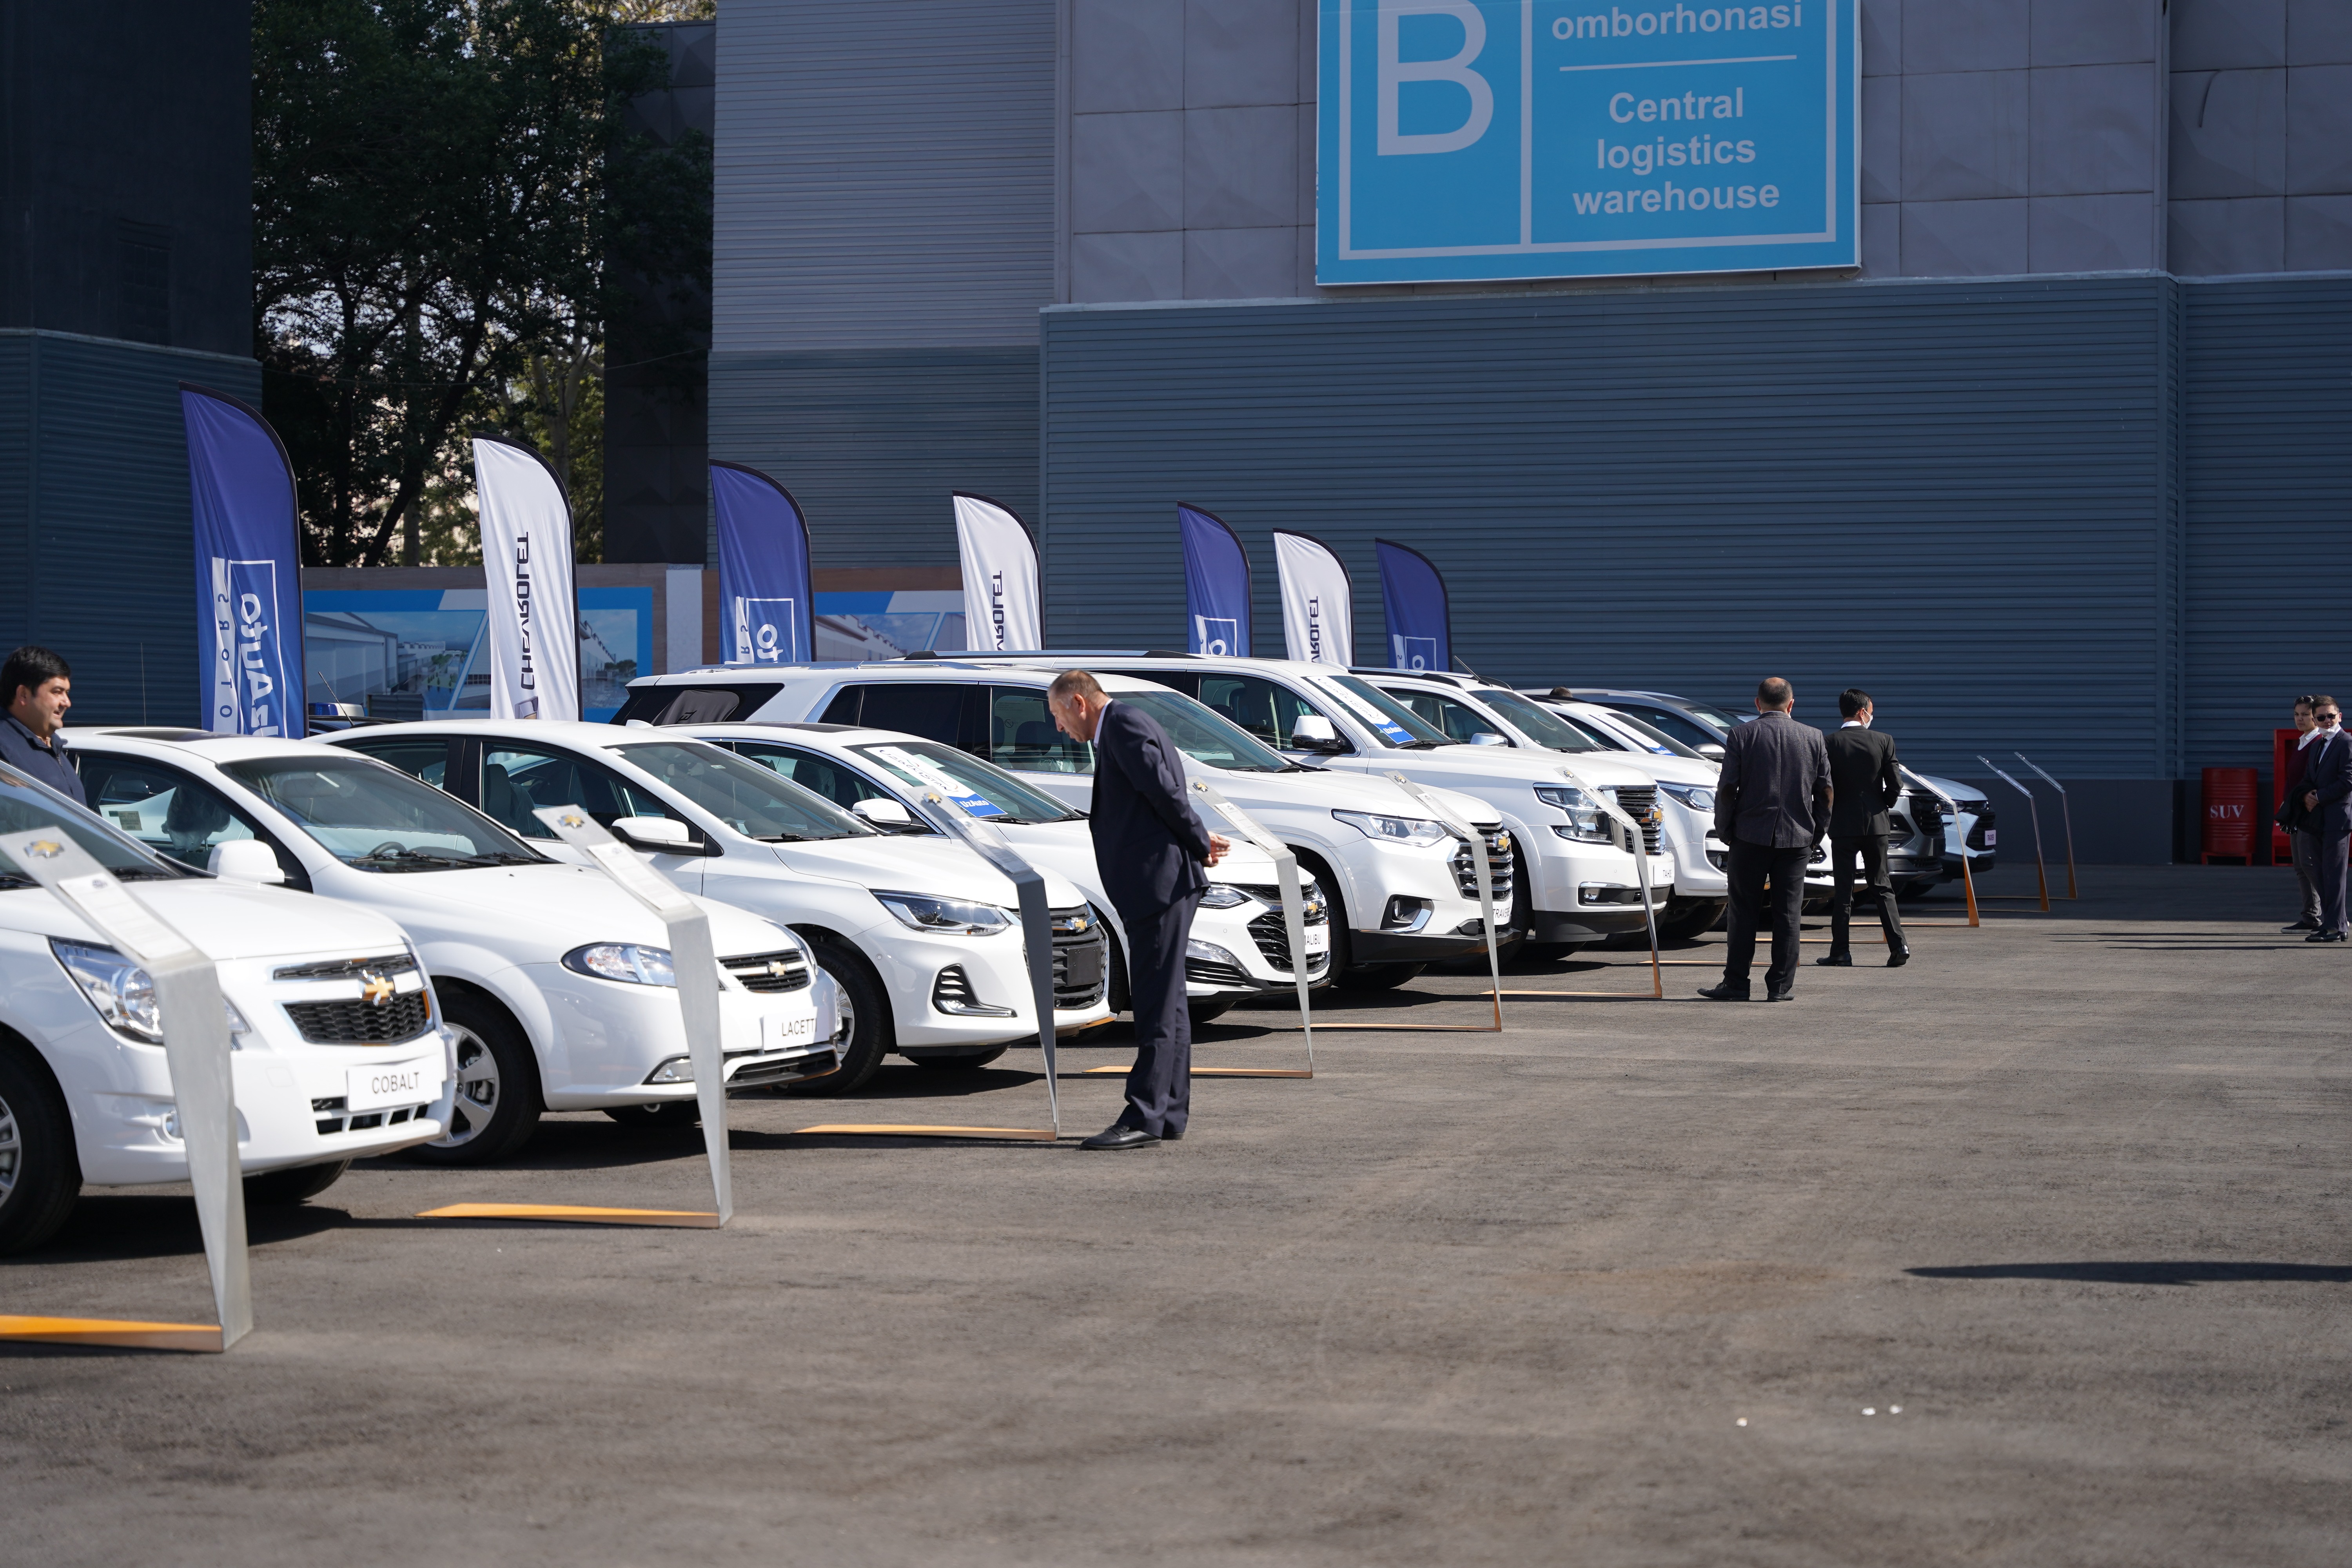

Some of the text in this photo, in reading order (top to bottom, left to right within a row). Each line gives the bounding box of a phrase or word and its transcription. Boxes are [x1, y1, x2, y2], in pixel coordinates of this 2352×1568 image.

[1552, 1, 1802, 40] omborhonasi
[1377, 0, 1494, 156] B
[1608, 87, 1744, 123] Central
[1597, 134, 1756, 176] logistics
[1573, 181, 1780, 215] warehouse
[2210, 805, 2244, 819] SUV
[782, 1018, 817, 1036] LACETTI
[372, 1071, 420, 1094] COBALT
